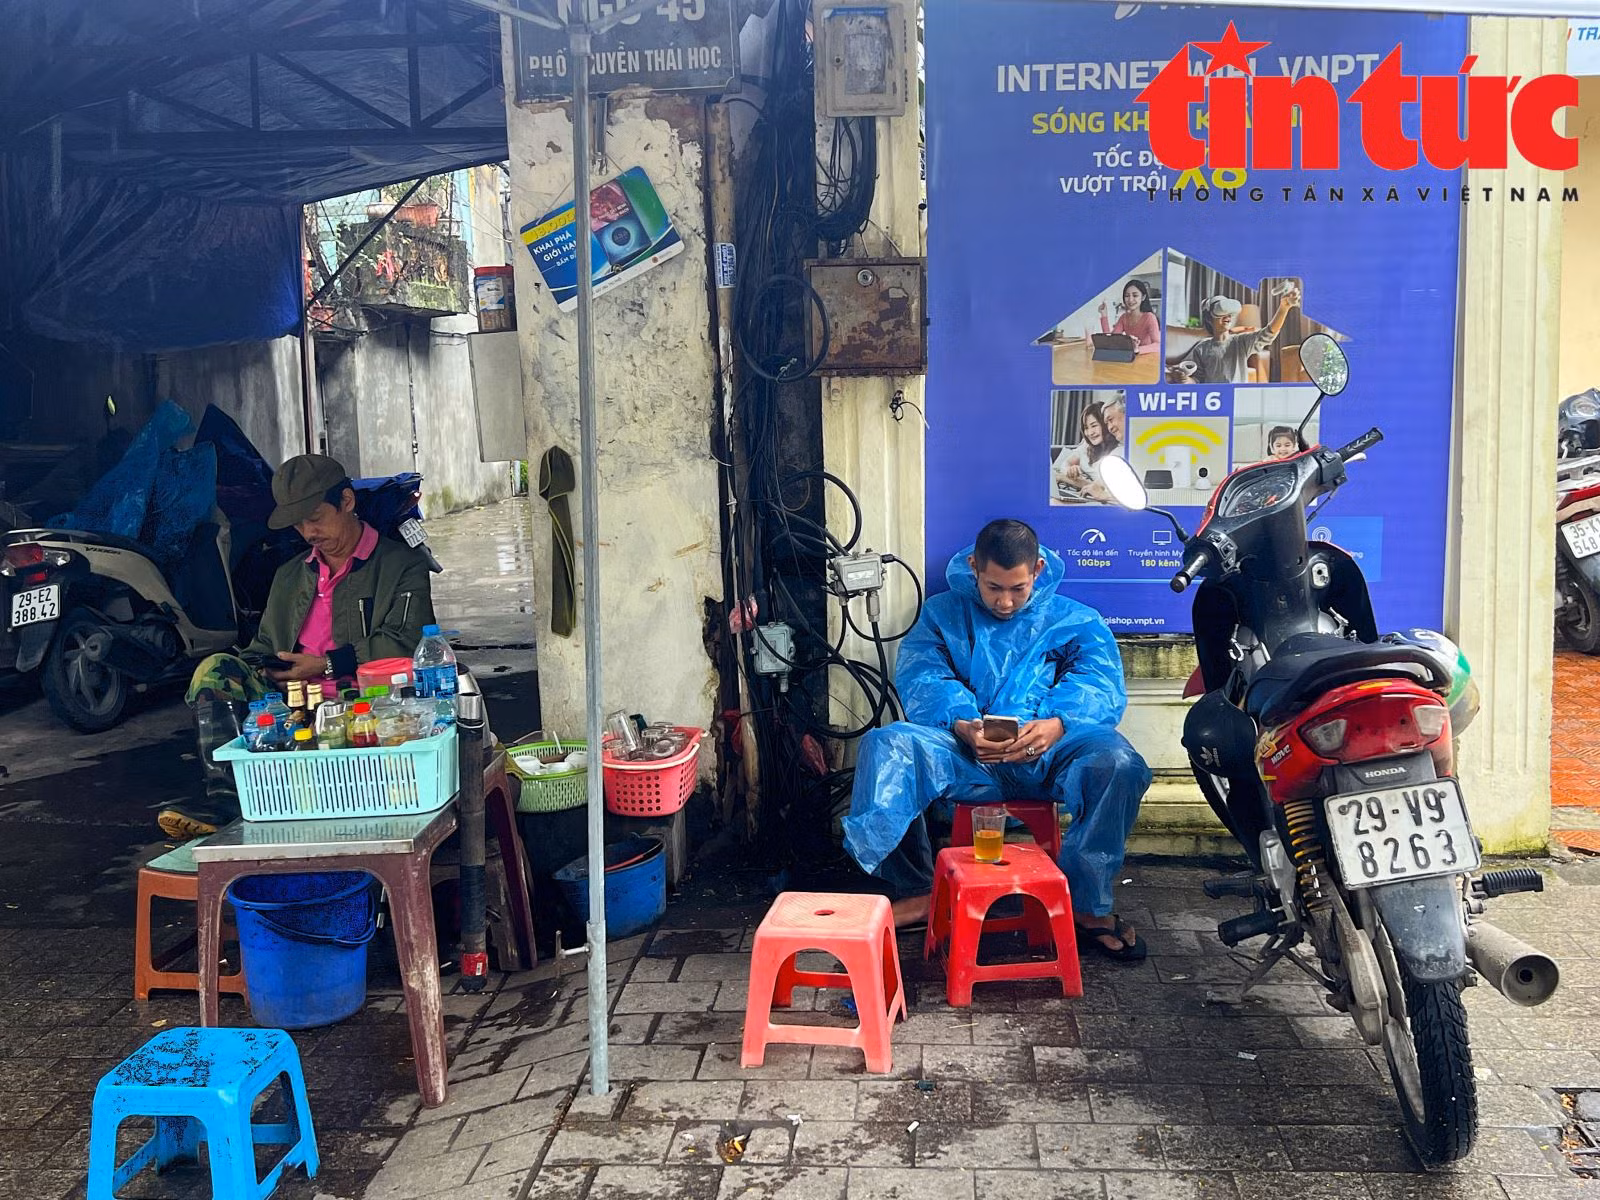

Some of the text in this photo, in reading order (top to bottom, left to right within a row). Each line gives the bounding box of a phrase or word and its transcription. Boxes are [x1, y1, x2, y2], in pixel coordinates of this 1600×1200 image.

[591, 41, 640, 75] UYỄN
[646, 41, 683, 72] THÁI
[688, 46, 721, 74] HỌC
[1032, 106, 1105, 134] SÓNG
[1092, 143, 1133, 168] TỐC
[1060, 171, 1167, 197] VƯỢT TRỘI
[533, 241, 554, 255] KHAI
[1138, 391, 1221, 411] WI-FI 6
[1172, 549, 1184, 558] My
[1573, 535, 1600, 555] 548
[1077, 559, 1111, 568] 10Gbps
[1141, 559, 1181, 567] 180 kênh
[14, 602, 56, 625] 388.42
[1103, 616, 1165, 627] gishop.vnpt.vn
[1364, 766, 1407, 778] HONDA
[1347, 788, 1446, 836] 29-V9
[1358, 829, 1458, 878] 8263
